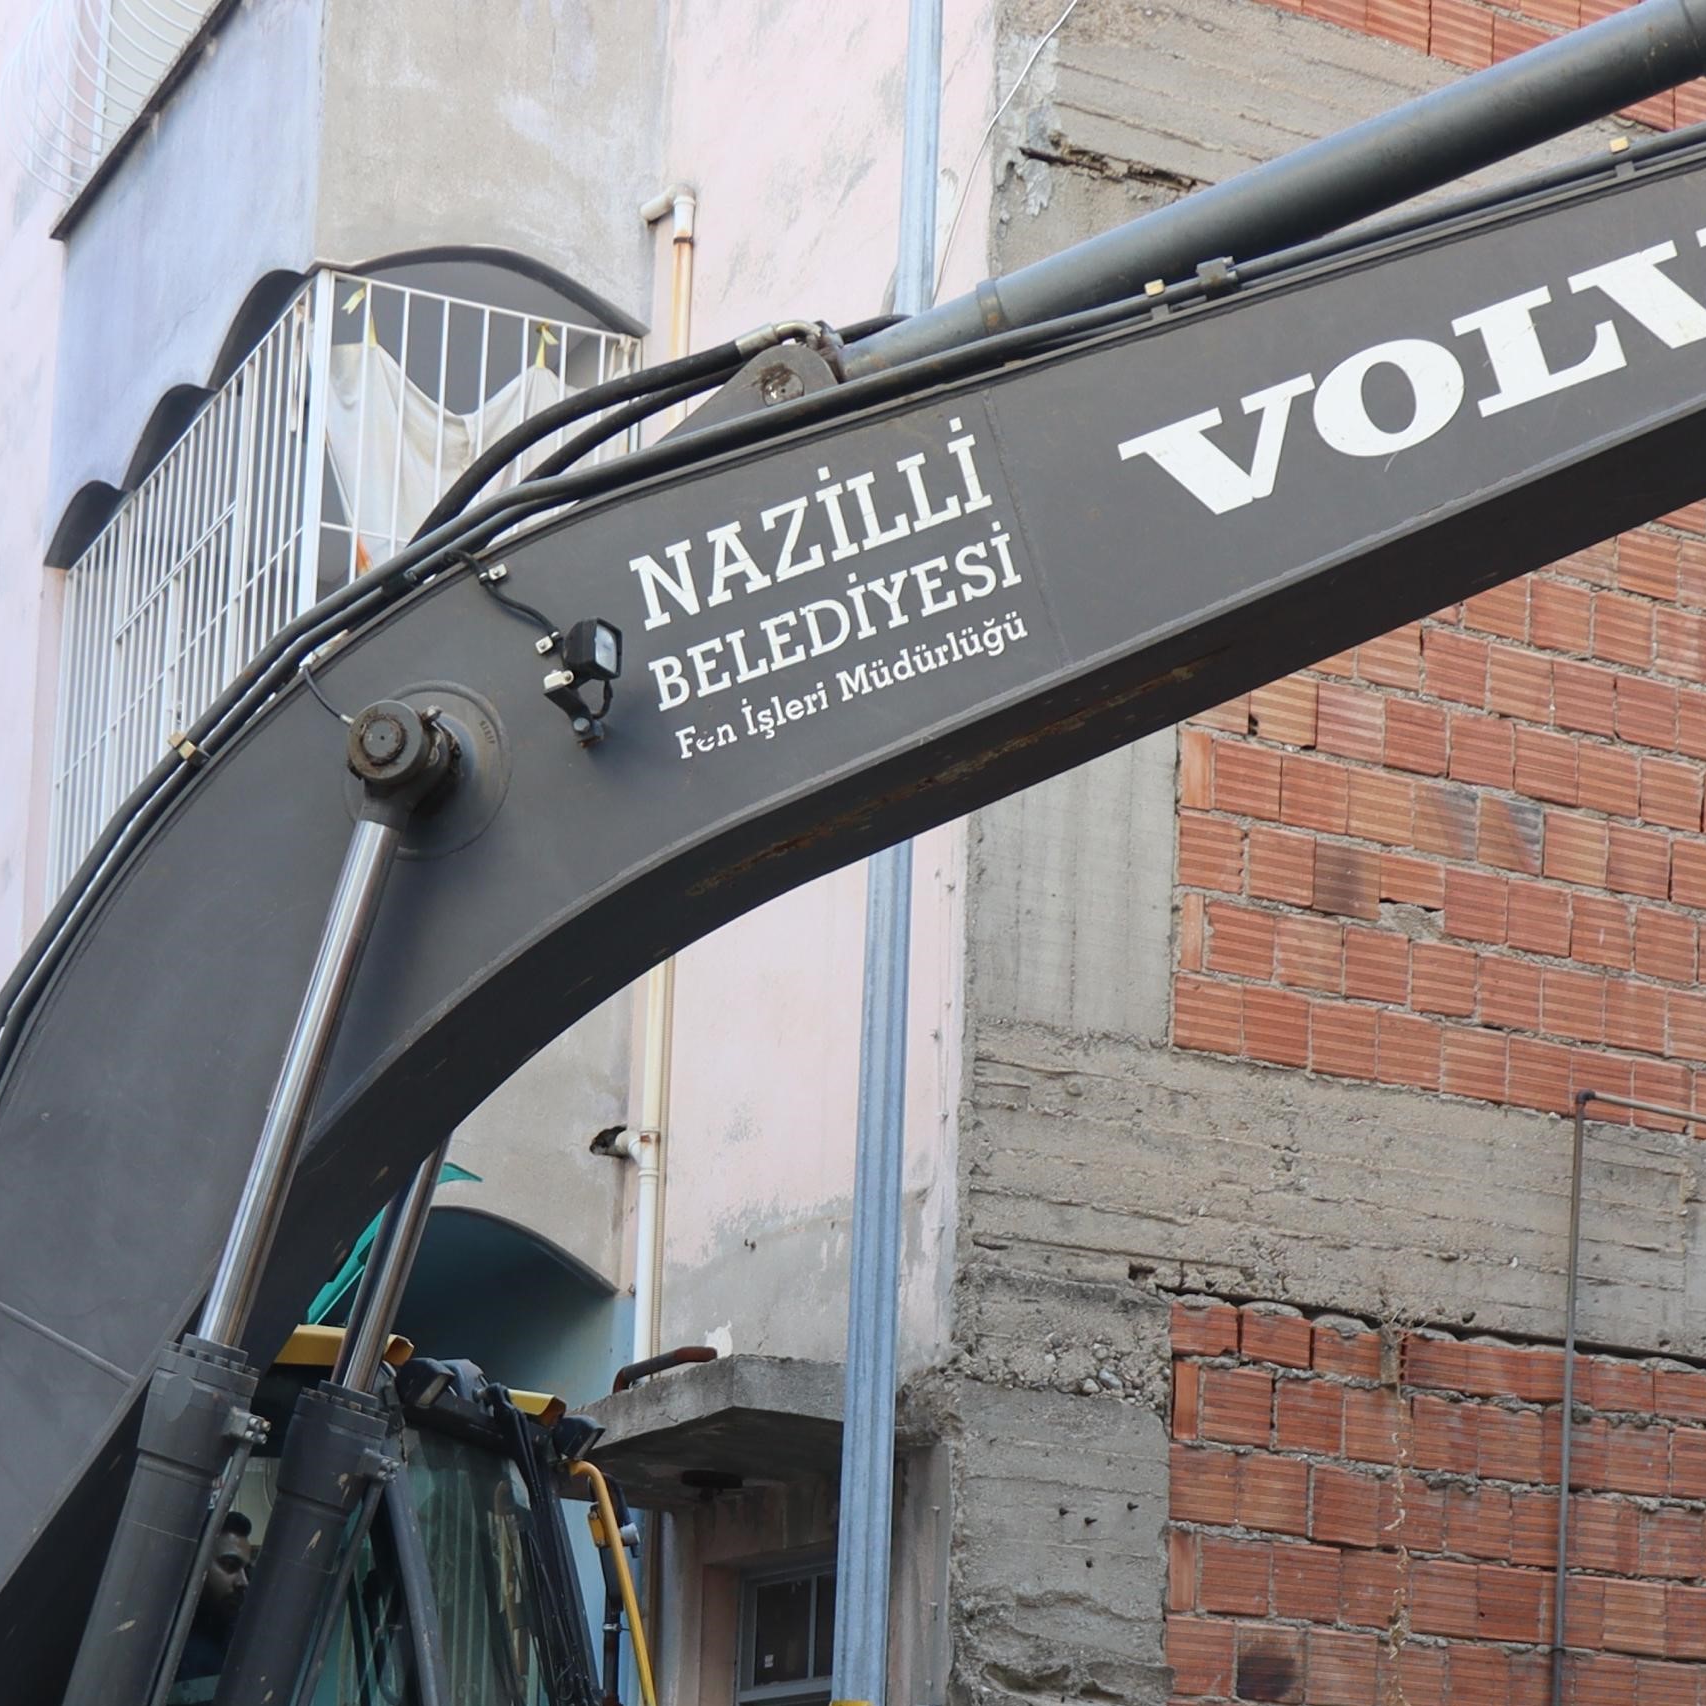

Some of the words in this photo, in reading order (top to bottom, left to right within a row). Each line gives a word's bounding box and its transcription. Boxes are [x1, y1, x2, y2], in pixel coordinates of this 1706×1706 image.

[629, 417, 992, 631] NAZİLLİ
[649, 521, 1022, 712] BELEDİYESİ
[742, 682, 829, 739] İşleri
[837, 611, 1028, 702] Müdürlüğü
